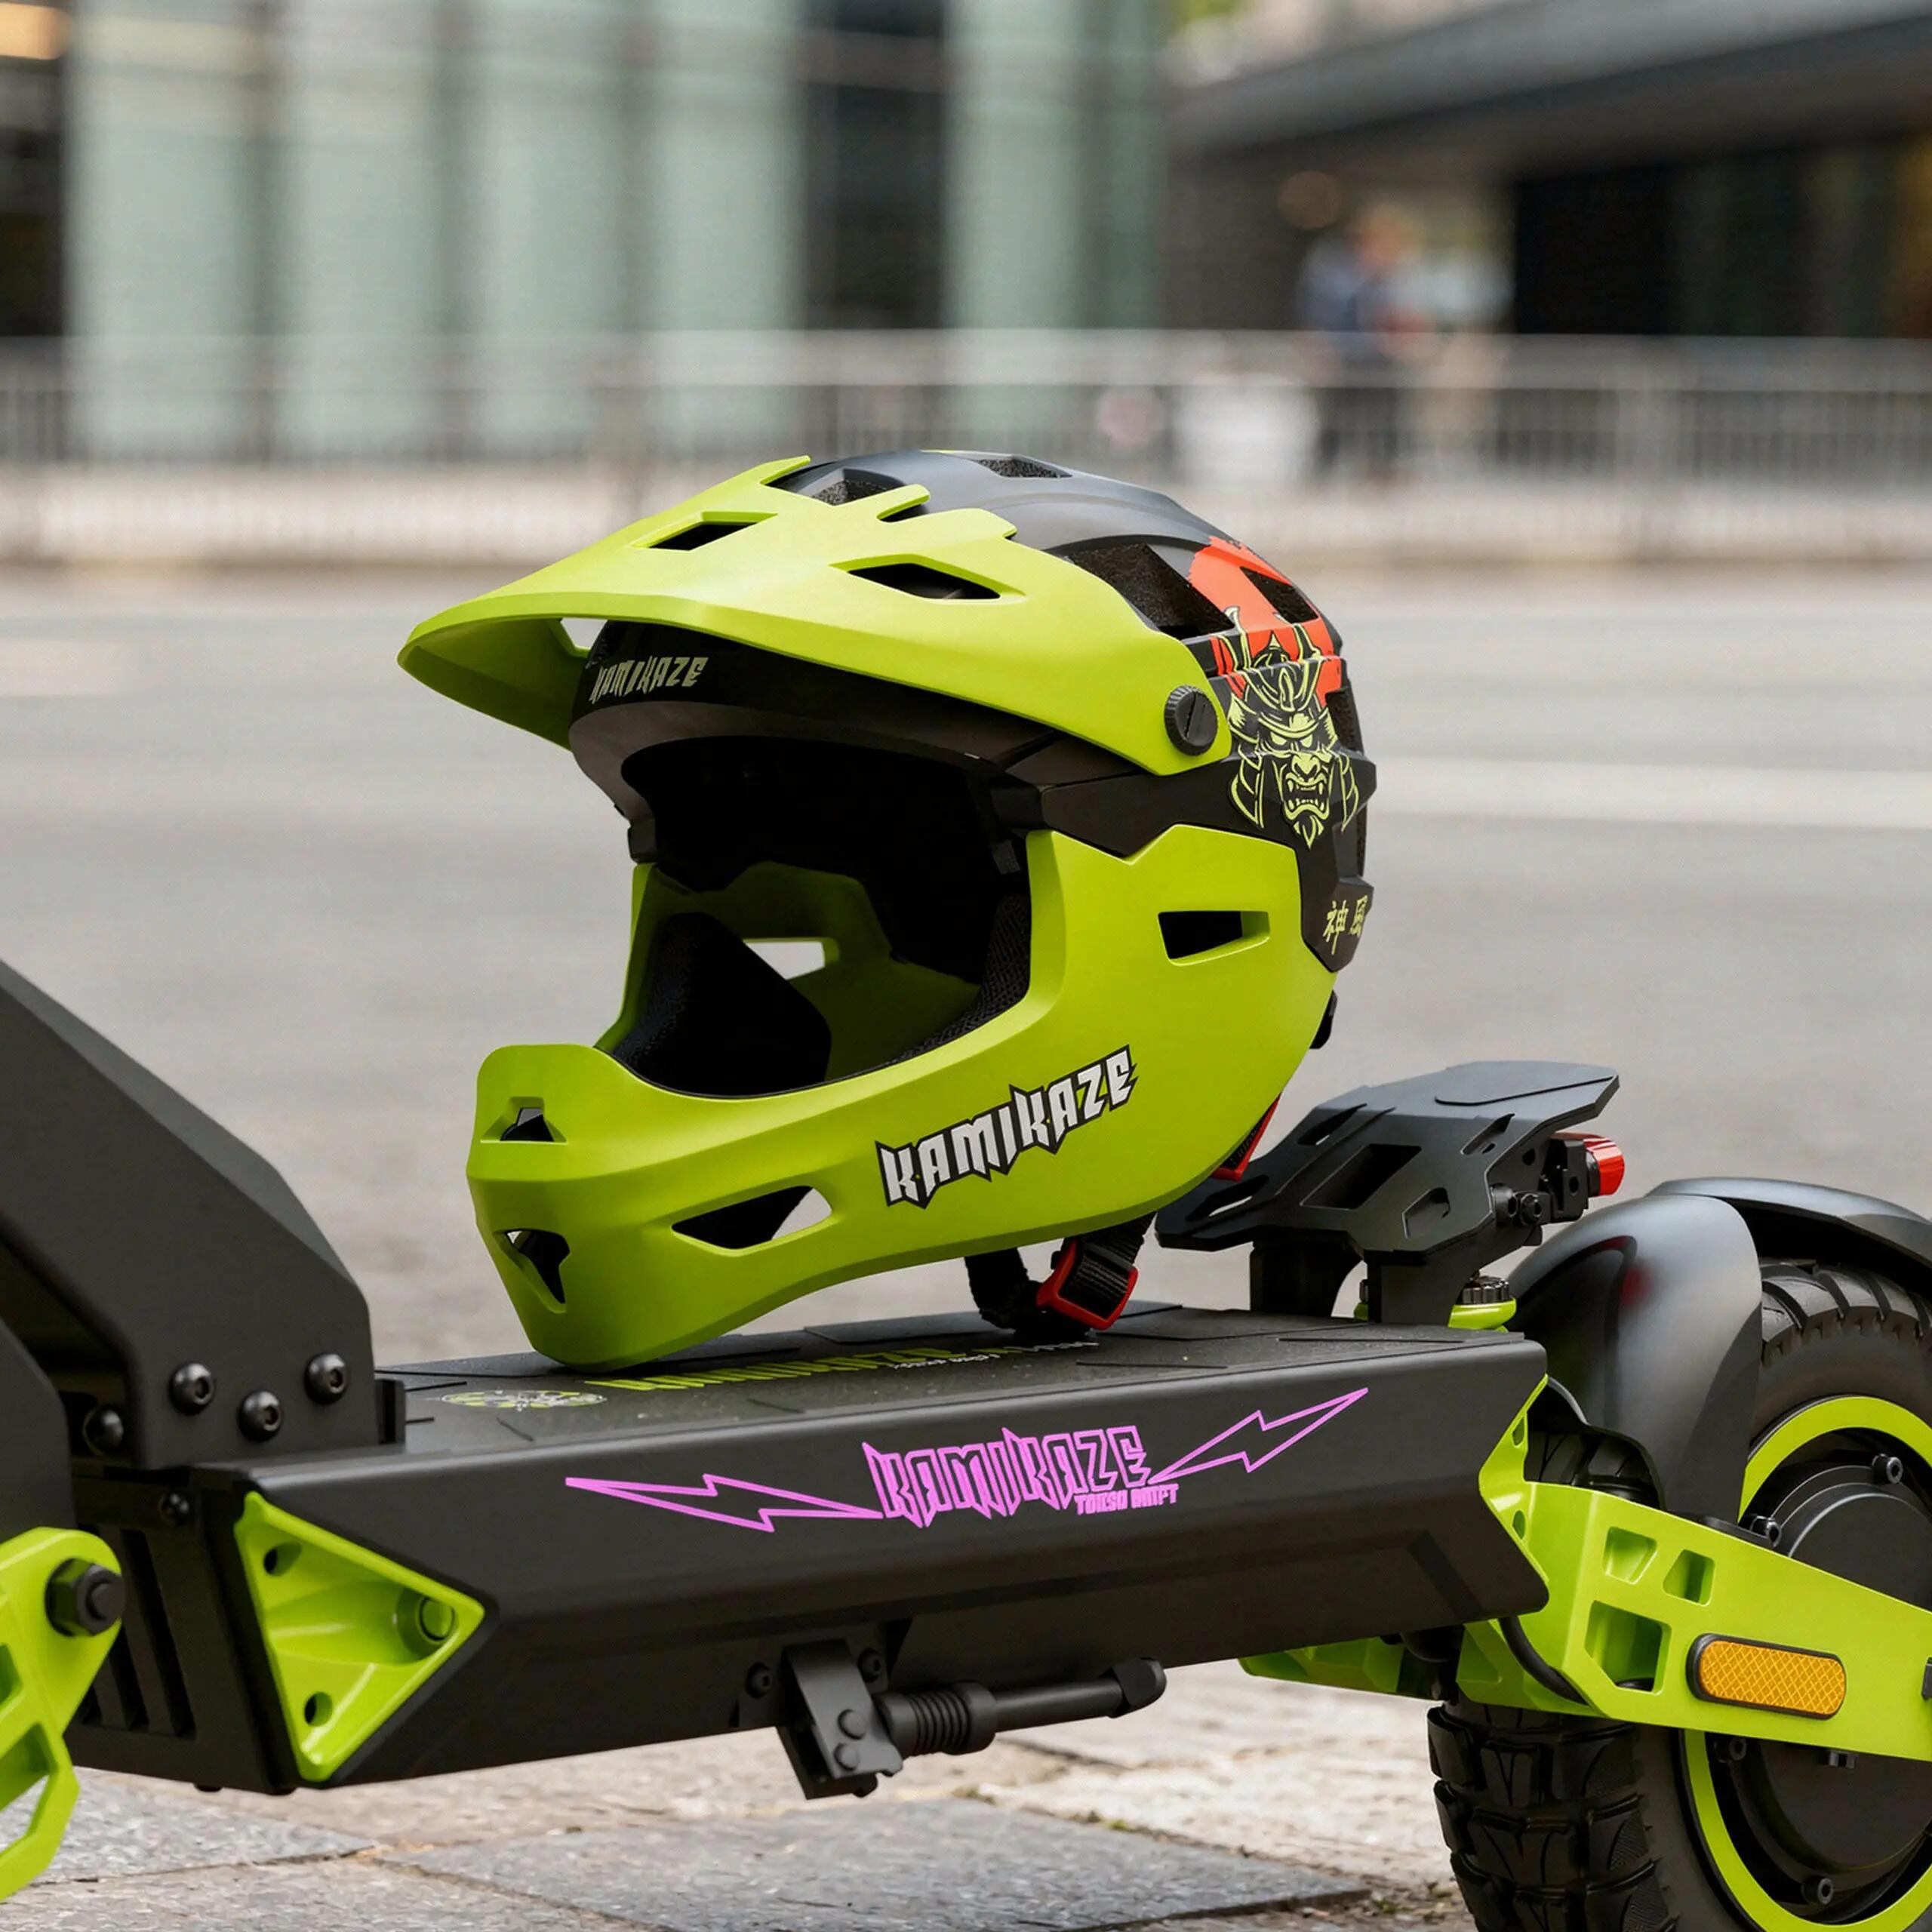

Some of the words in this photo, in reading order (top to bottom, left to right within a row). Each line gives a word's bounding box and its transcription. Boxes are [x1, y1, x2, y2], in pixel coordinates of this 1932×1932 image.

[589, 655, 709, 705] KAMIKAZE
[875, 1044, 1138, 1209] KAMIKAZE
[862, 1425, 1152, 1528] KAMIKAZE
